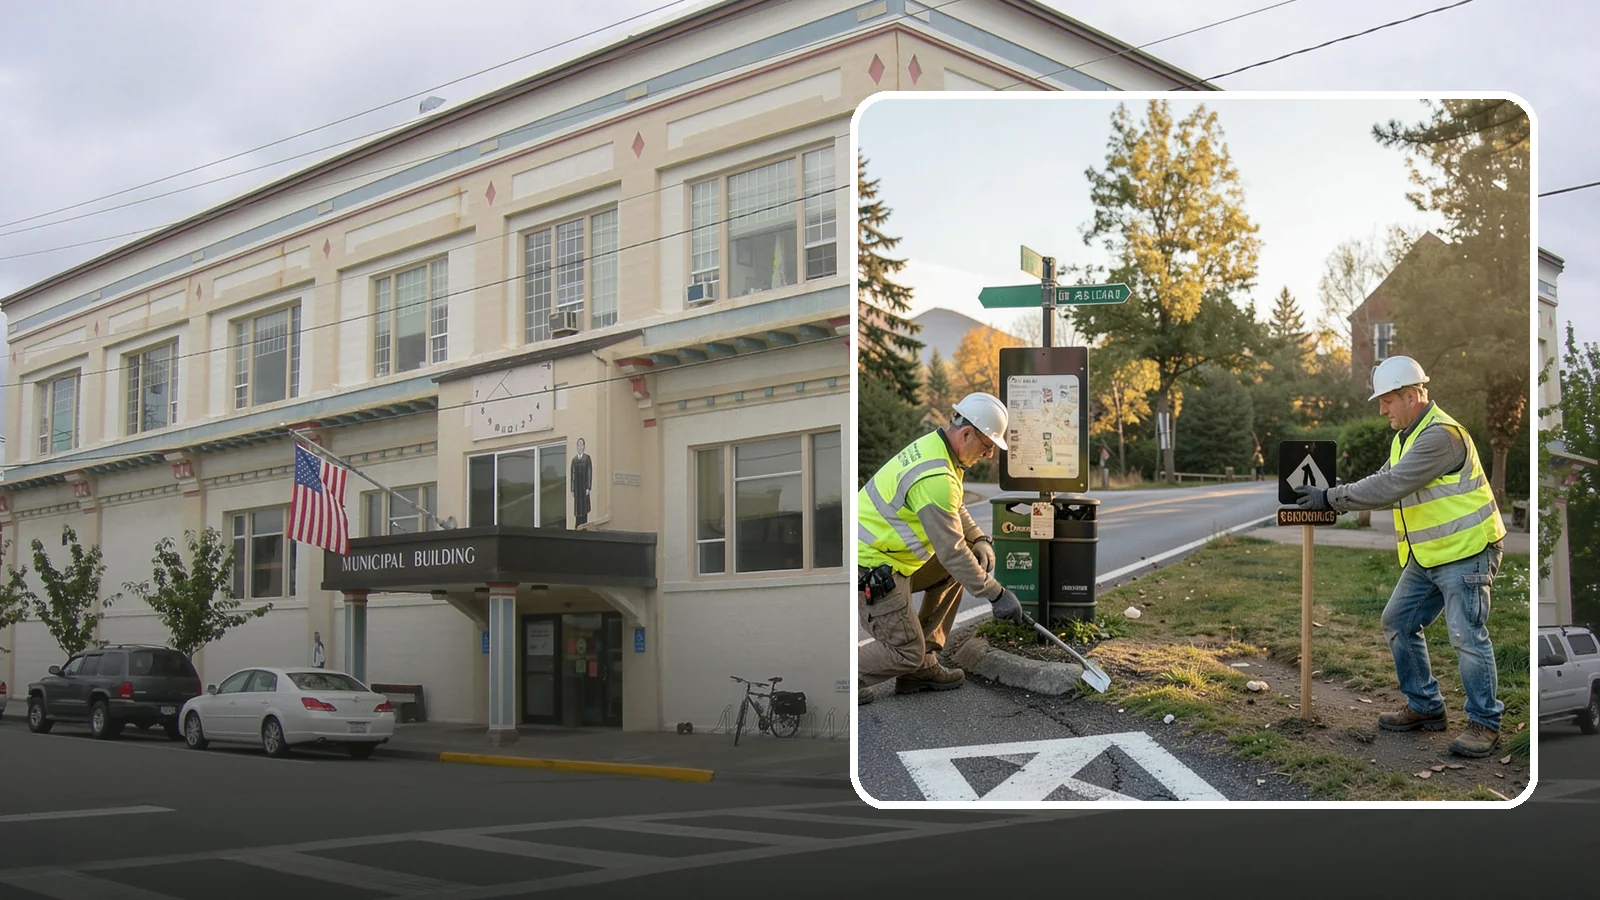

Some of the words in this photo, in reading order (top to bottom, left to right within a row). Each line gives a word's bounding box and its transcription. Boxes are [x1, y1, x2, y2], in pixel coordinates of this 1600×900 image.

[475, 390, 479, 398] 7
[536, 402, 540, 410] 4
[480, 407, 485, 415] 8
[487, 417, 492, 426] 9
[528, 414, 533, 422] 3
[494, 423, 500, 432] 10
[521, 420, 526, 428] 2
[501, 425, 506, 434] 11
[507, 425, 513, 433] 12
[342, 552, 405, 572] MUNICIPAL
[414, 546, 475, 567] BUILDING
